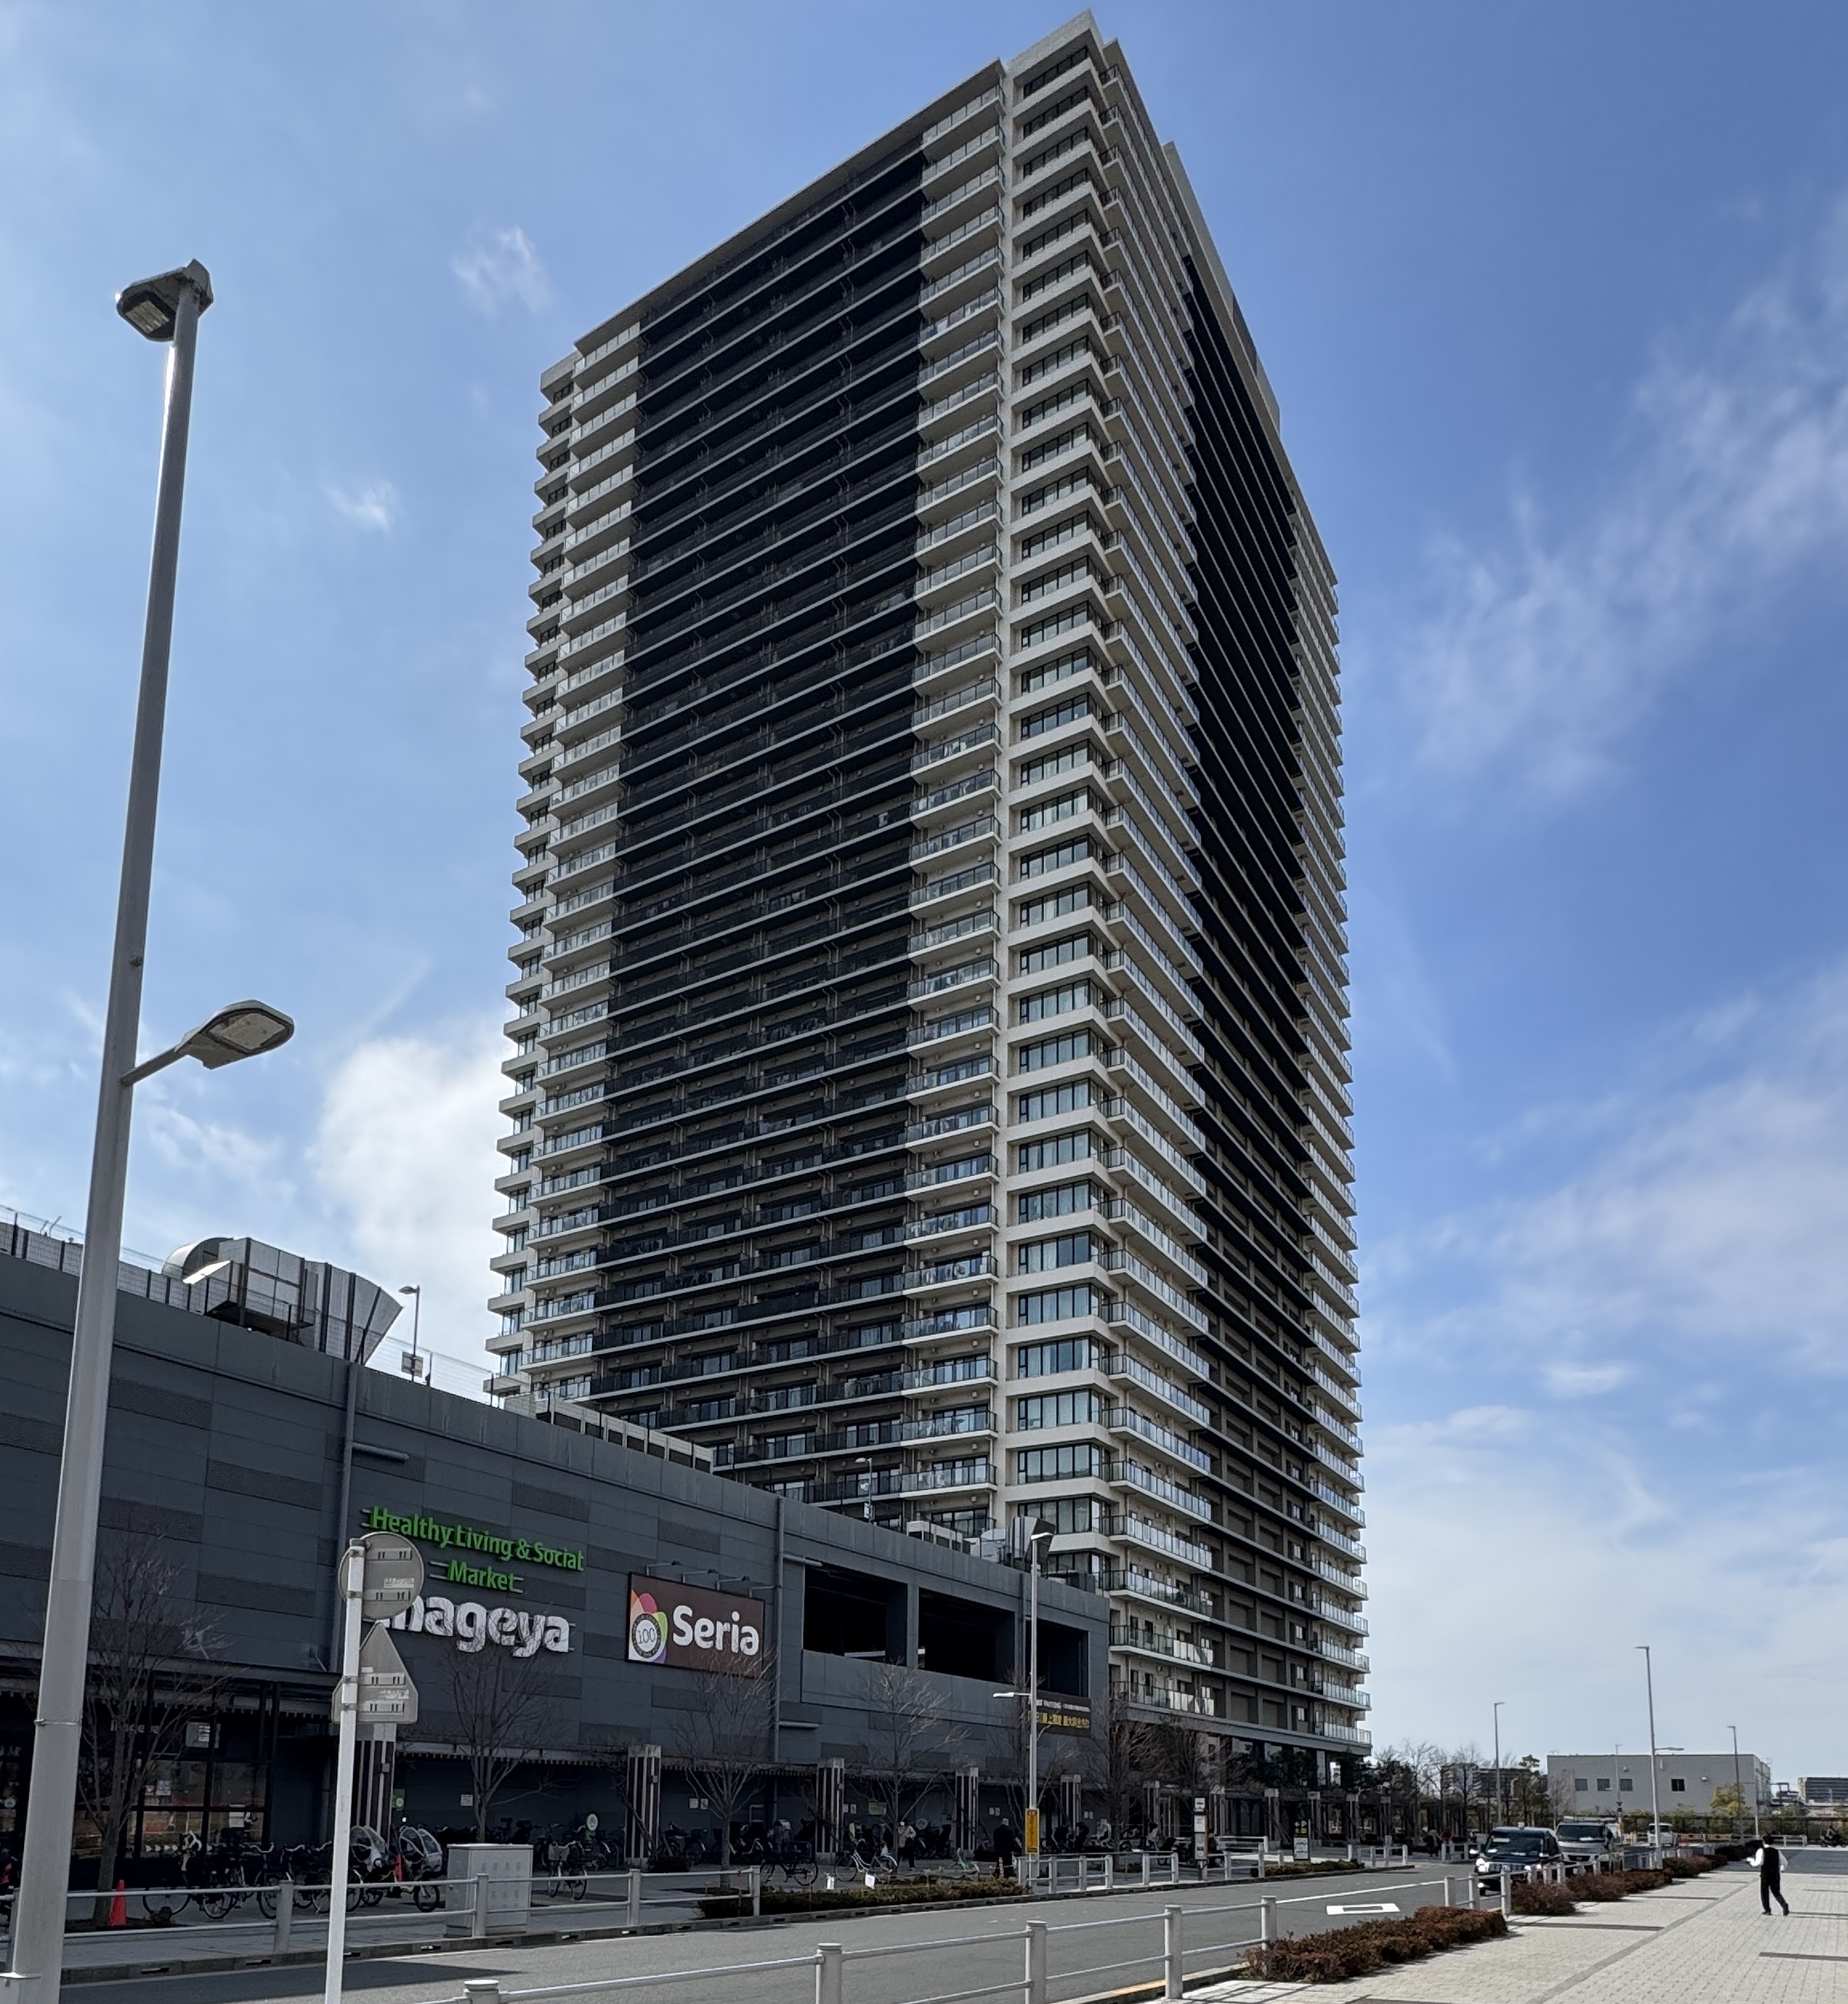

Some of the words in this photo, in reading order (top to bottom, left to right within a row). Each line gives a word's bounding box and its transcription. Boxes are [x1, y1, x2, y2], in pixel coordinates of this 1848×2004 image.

[371, 1506, 453, 1549] Healthy
[455, 1524, 512, 1562] Living
[516, 1538, 530, 1560] &
[533, 1541, 584, 1571] Social
[447, 1559, 516, 1593] Market
[375, 1595, 570, 1657] nageya
[637, 1627, 656, 1644] 100
[673, 1605, 759, 1656] Seria
